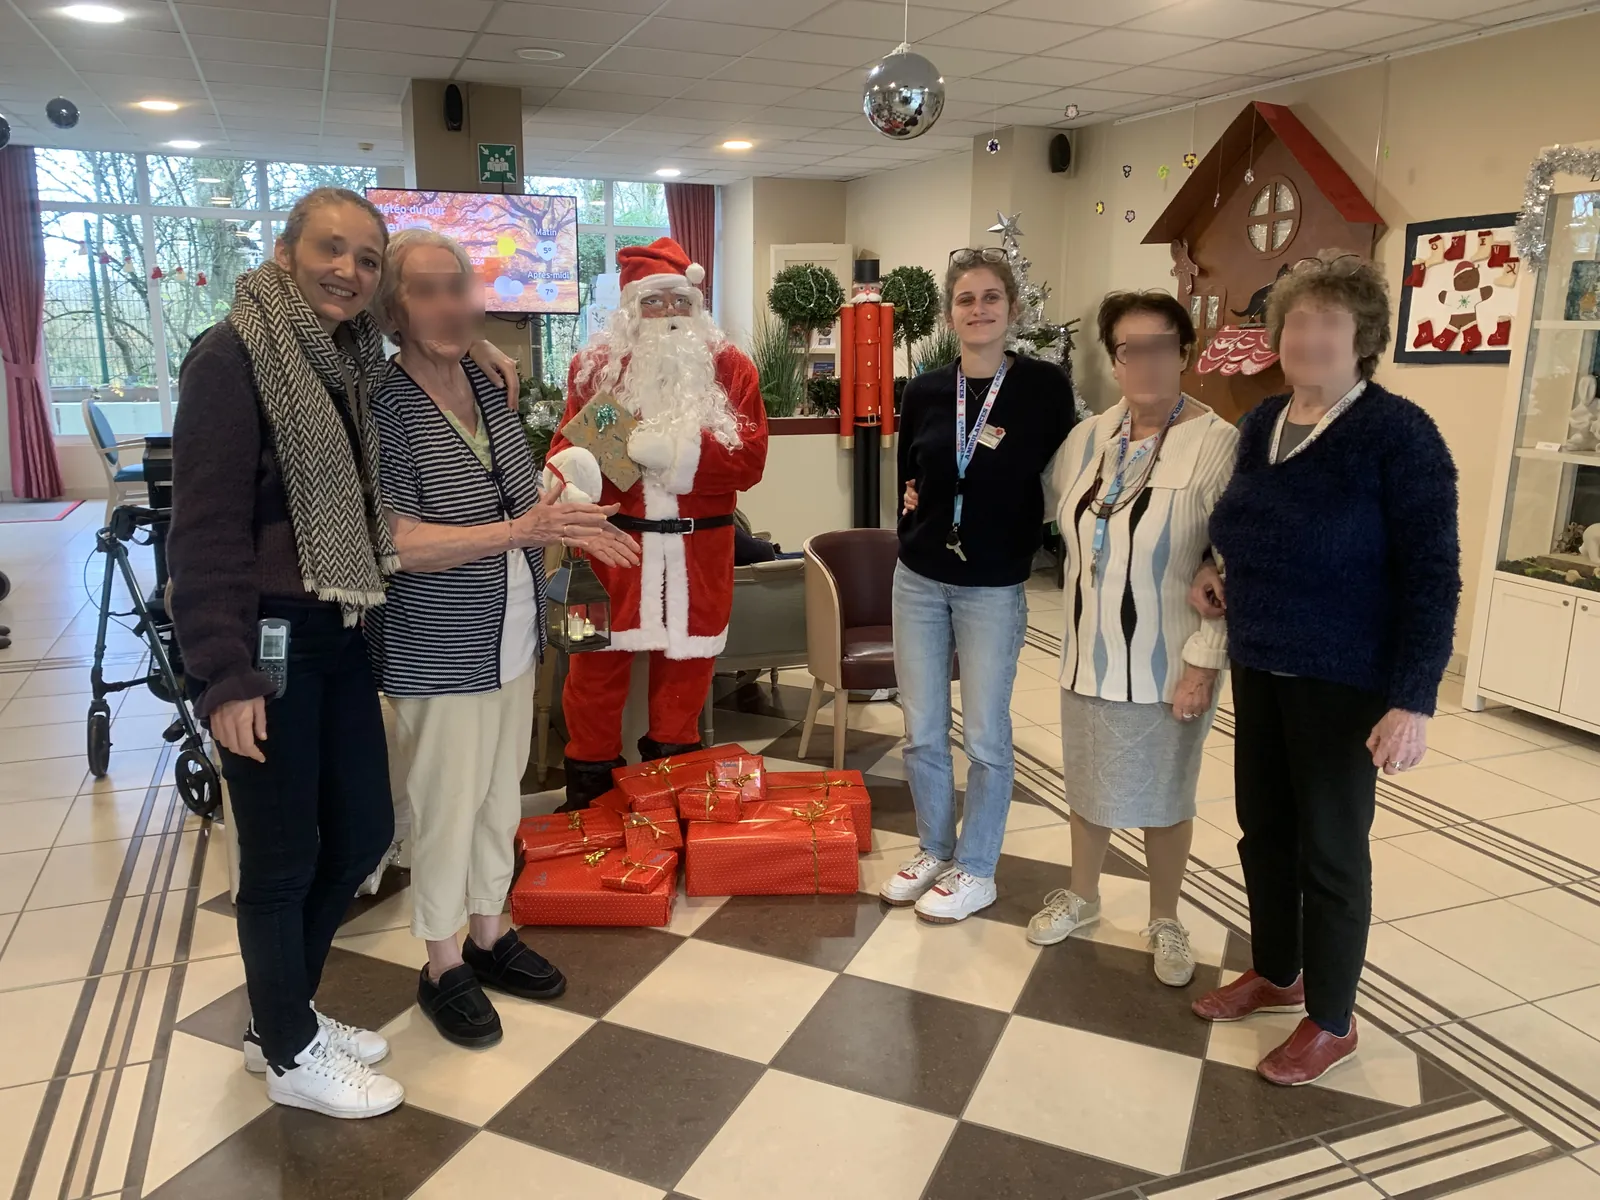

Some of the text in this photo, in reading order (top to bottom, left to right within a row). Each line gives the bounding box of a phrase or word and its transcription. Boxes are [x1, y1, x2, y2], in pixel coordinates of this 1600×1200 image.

[409, 204, 423, 214] du
[425, 205, 446, 215] jour
[535, 228, 557, 237] Matin
[527, 270, 570, 280] Après-midi
[964, 407, 988, 461] AMBULANCES
